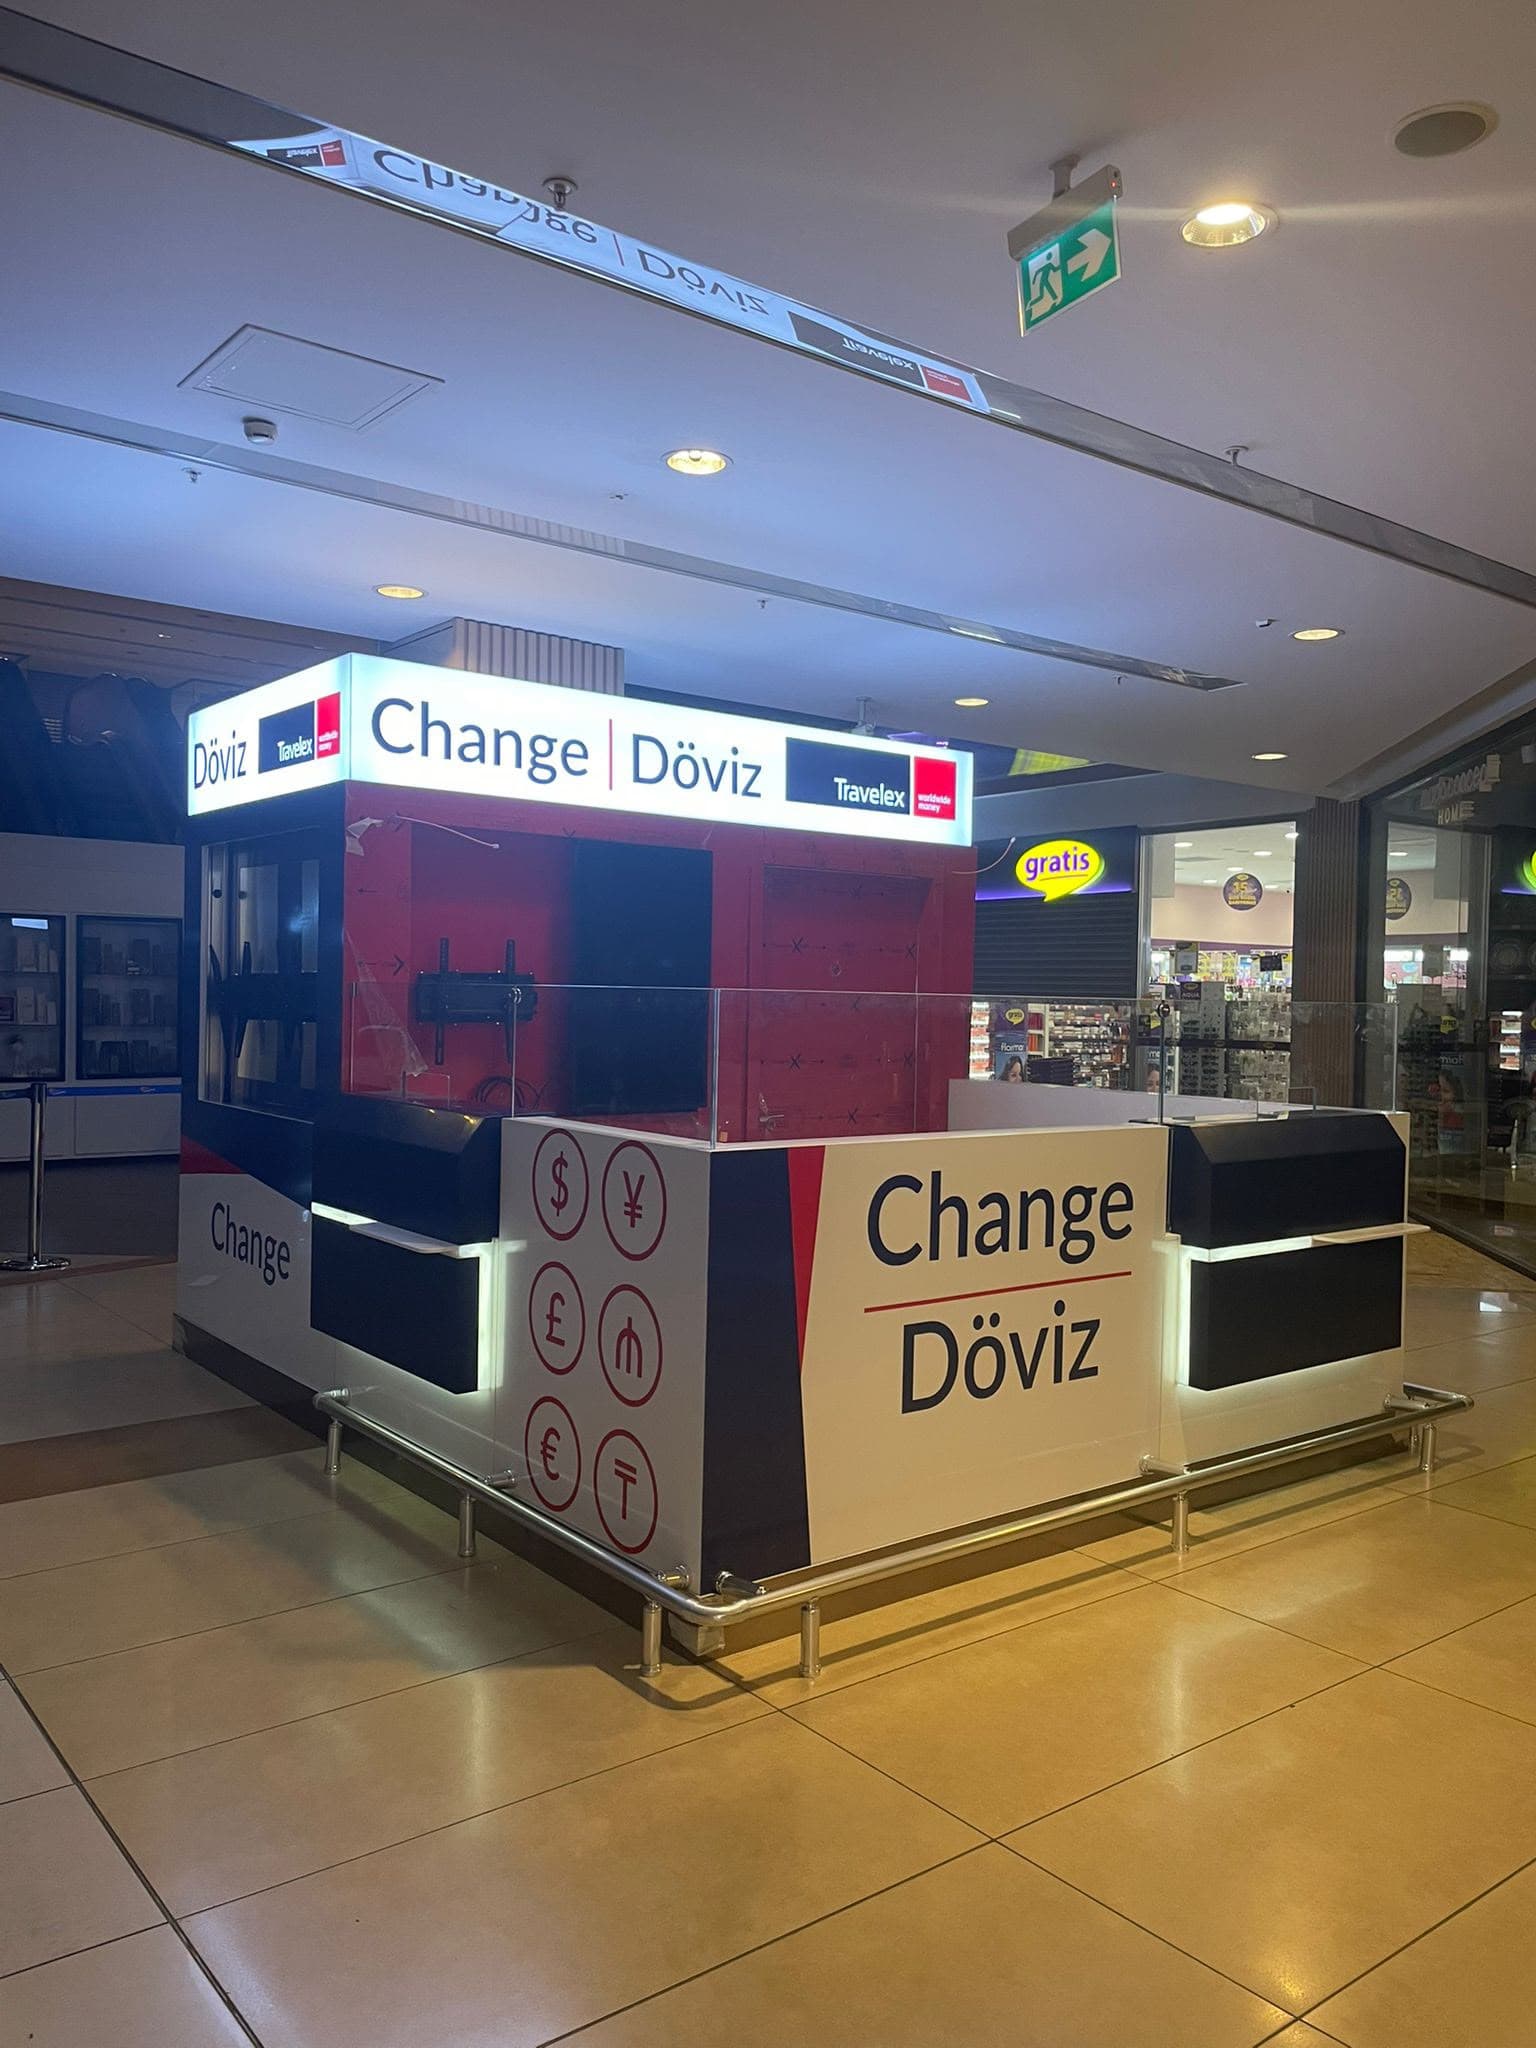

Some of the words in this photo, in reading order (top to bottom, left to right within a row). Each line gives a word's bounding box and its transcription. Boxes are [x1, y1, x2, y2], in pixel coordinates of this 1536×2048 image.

[194, 729, 247, 790] Döviz
[277, 735, 313, 762] Travelex
[371, 697, 589, 785] Change
[632, 733, 763, 798] Döviz
[833, 777, 906, 808] Travelex
[1025, 845, 1090, 882] gratis
[211, 1202, 291, 1286] Change
[865, 1170, 1135, 1267] Change
[901, 1299, 1101, 1415] Döviz
